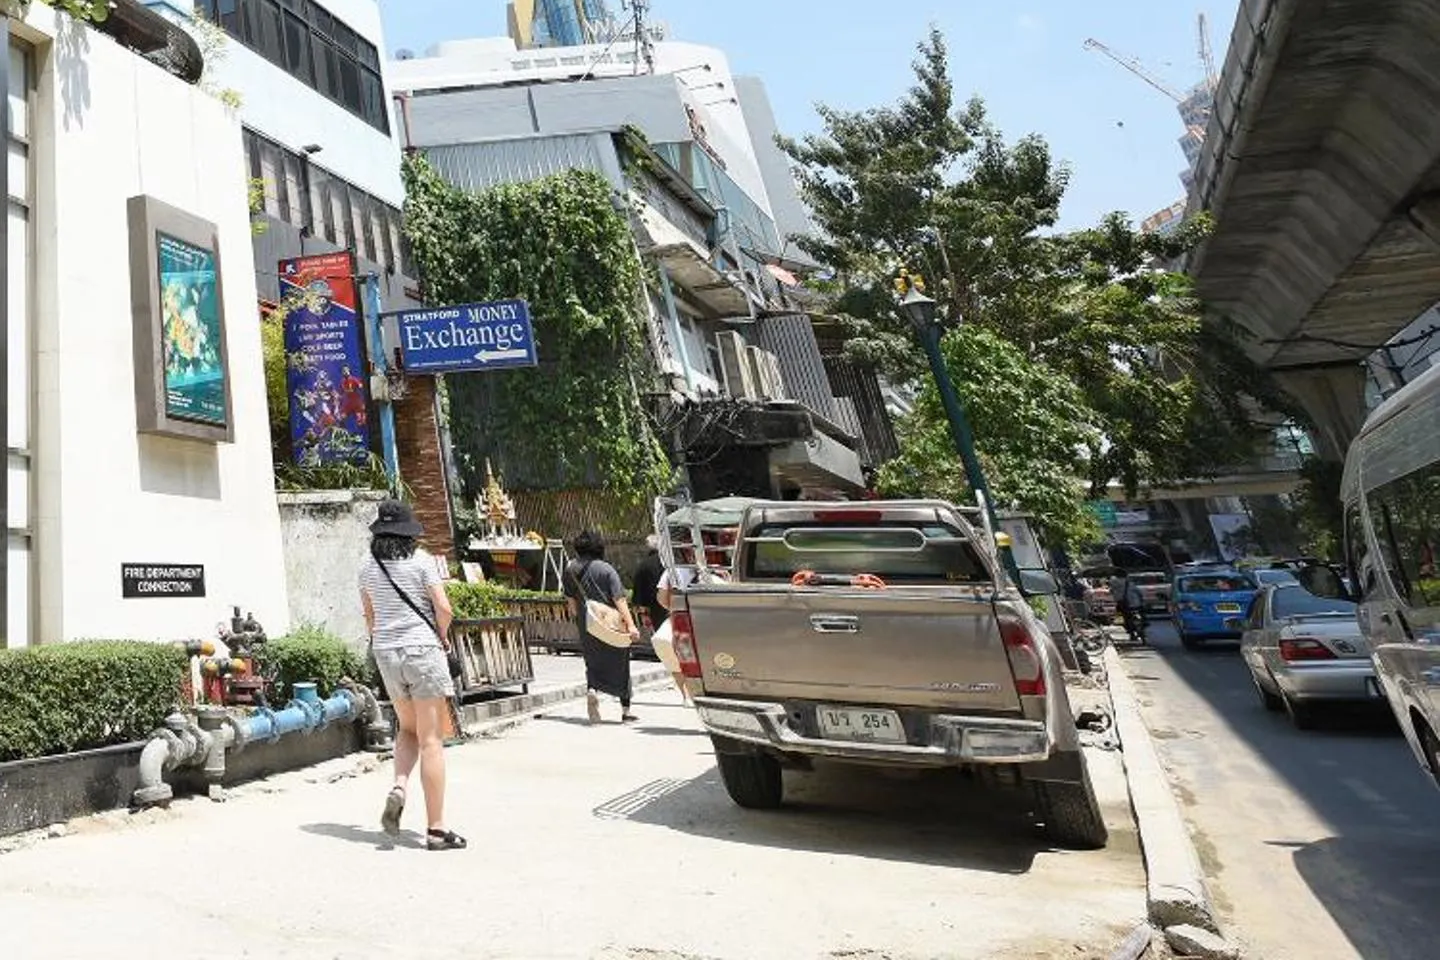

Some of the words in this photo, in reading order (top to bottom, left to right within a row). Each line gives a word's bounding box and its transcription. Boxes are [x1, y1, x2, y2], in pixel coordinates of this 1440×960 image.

[403, 310, 460, 323] STRATFORD
[467, 304, 518, 323] MONEY
[404, 321, 524, 351] Exchange
[124, 567, 144, 578] FIRE
[146, 567, 202, 578] DEPARTMENT
[137, 581, 193, 592] CONNECTION
[861, 713, 890, 728] 254
